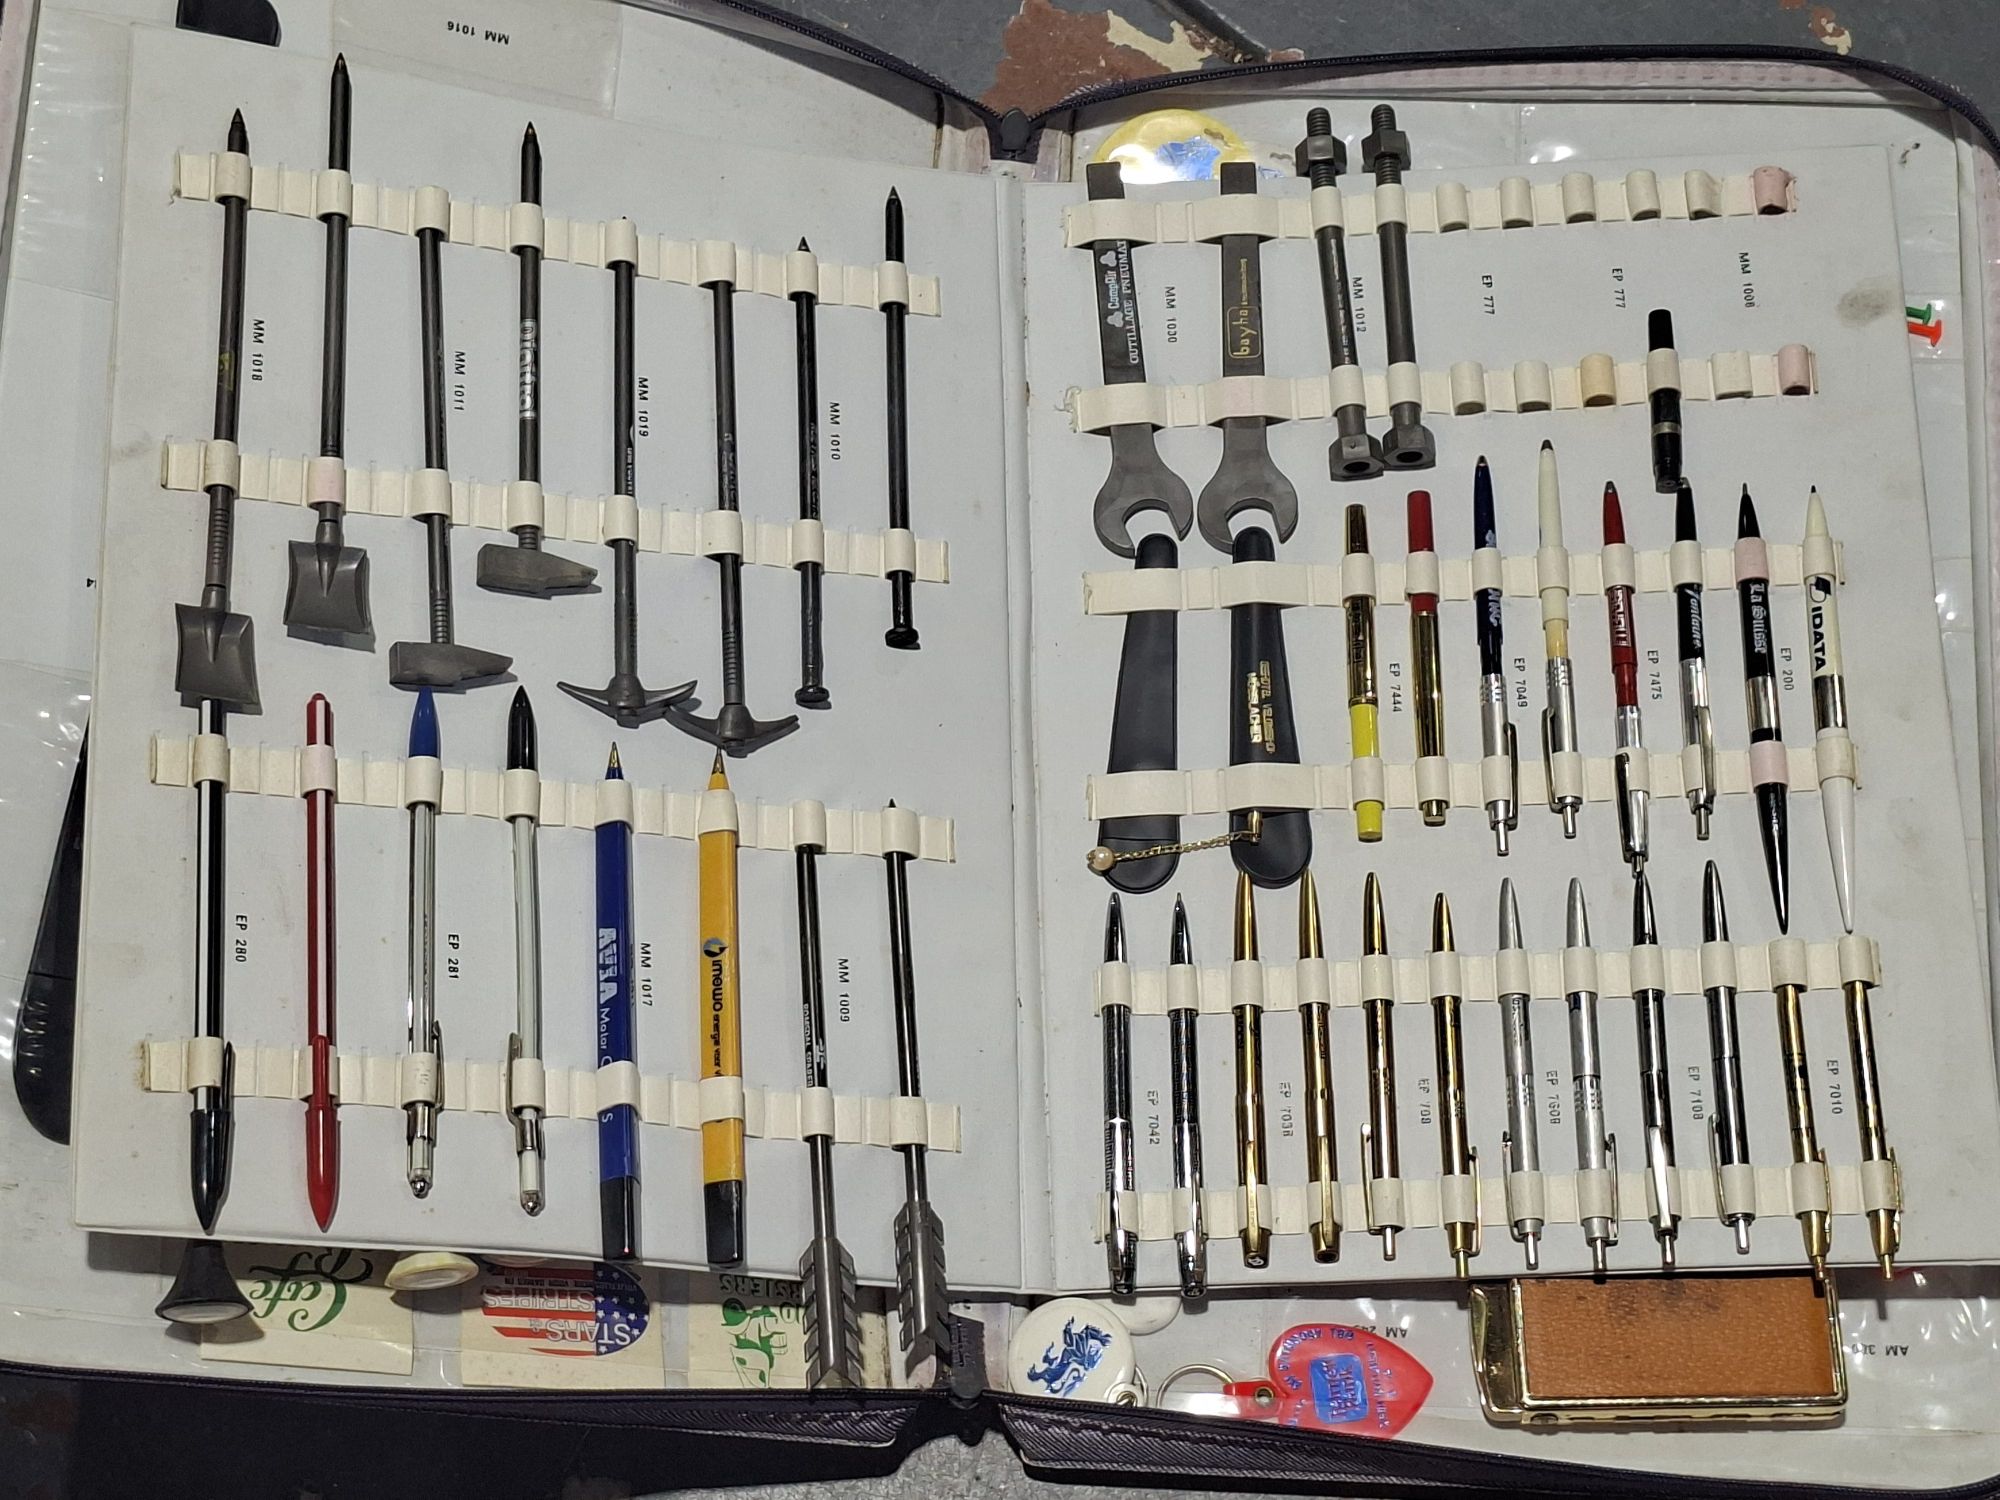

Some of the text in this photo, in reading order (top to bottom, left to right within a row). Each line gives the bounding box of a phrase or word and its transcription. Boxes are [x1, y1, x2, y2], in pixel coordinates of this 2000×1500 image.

[447, 20, 510, 46] MM 1016
[1738, 251, 1752, 275] MM
[1164, 286, 1177, 310] MM
[1352, 276, 1367, 333] MM 1012
[1481, 274, 1496, 315] EP 777
[1611, 267, 1627, 309] EP 777
[251, 318, 265, 382] MM 1018
[1123, 299, 1140, 365] OUTILLAGE
[453, 350, 467, 411] MM 1011
[636, 376, 650, 438] MM 1019
[829, 401, 841, 461] MM 1010
[1811, 606, 1827, 672] IDATA
[1388, 662, 1403, 713] EP 7444
[1513, 657, 1529, 708] EP 7049
[1646, 649, 1663, 701] EP 7475
[1779, 647, 1795, 691] EP 200
[234, 914, 249, 963] EP 280
[447, 933, 460, 979] EP 281
[639, 942, 653, 1007] MM 1017
[837, 958, 851, 1023] MM 1009
[1545, 1069, 1559, 1086] EP
[1687, 1065, 1701, 1082] EP
[1826, 1059, 1844, 1115] EP 7010
[1147, 1114, 1161, 1145] 7042
[482, 1286, 596, 1313] STRIPES
[546, 1319, 632, 1346] STARS
[1386, 1326, 1408, 1338] AM
[1884, 1345, 1909, 1357] AM
